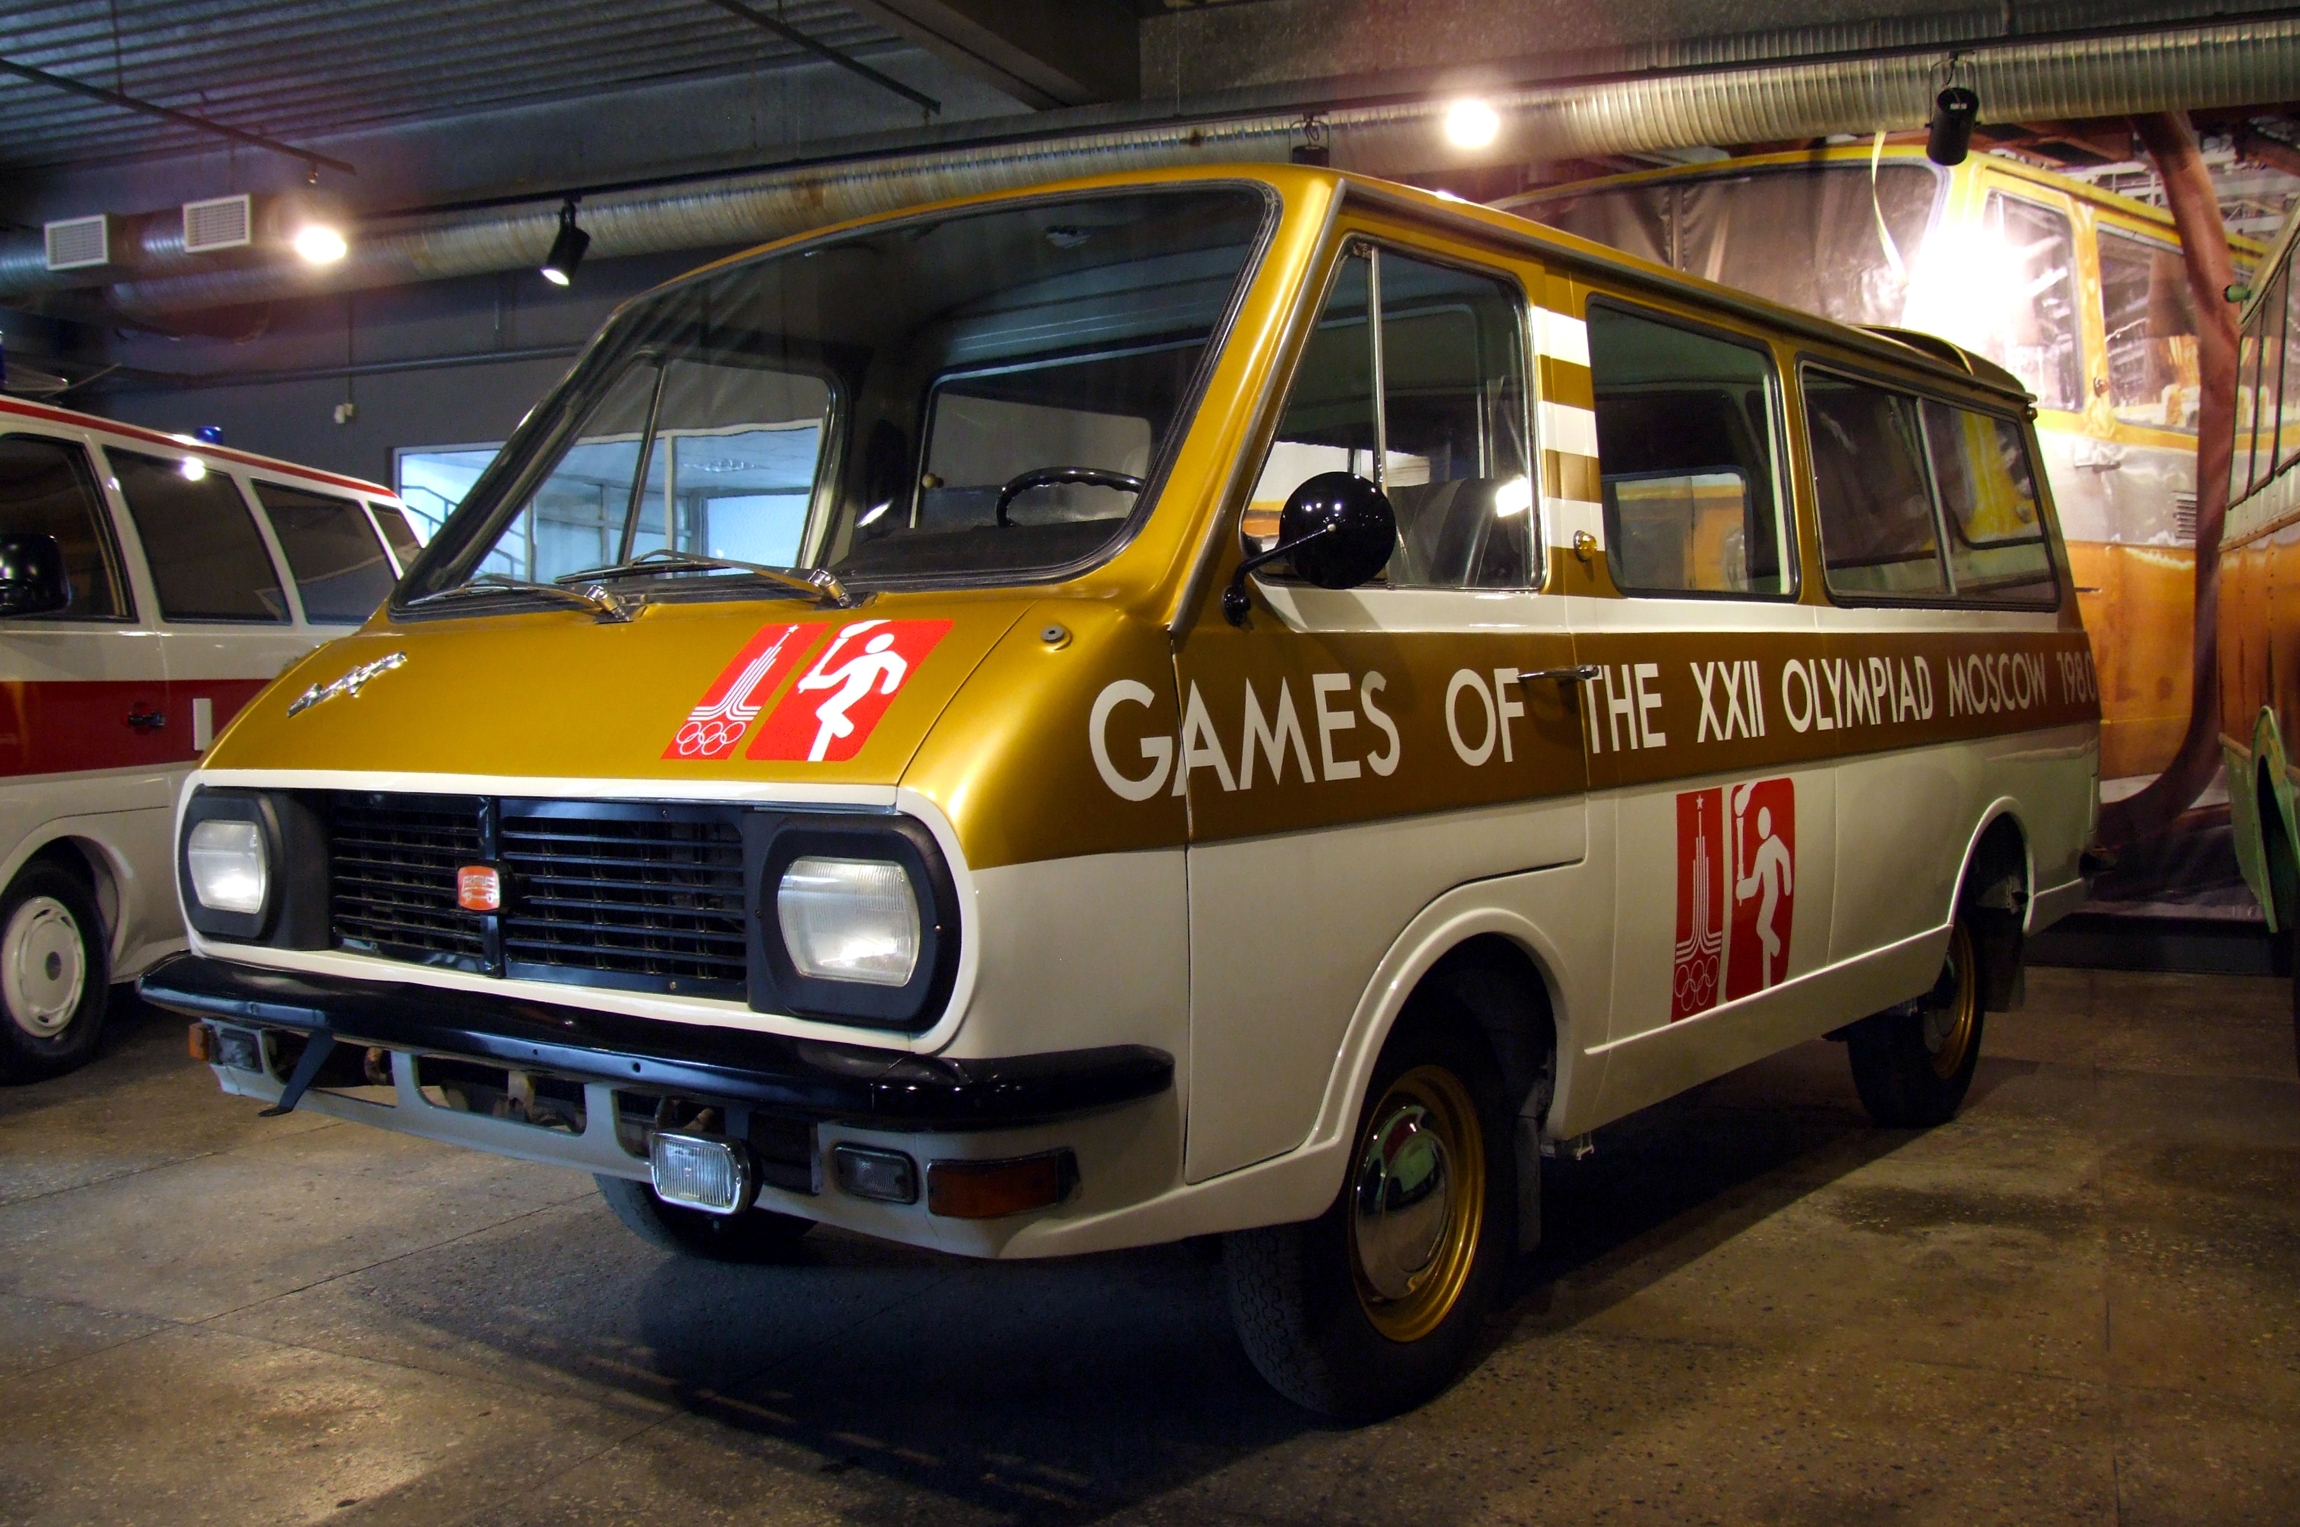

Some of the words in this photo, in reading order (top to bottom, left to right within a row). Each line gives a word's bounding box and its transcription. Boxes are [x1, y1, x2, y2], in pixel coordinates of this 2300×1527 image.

[1089, 671, 1400, 801] GAMES
[1445, 668, 1524, 766] OF
[1586, 663, 1667, 754] THE
[1690, 660, 1765, 743] XXII
[1782, 656, 1933, 733] OLYMPIAD
[1947, 652, 2047, 717] MOSCOW
[2056, 651, 2096, 704] 1980
